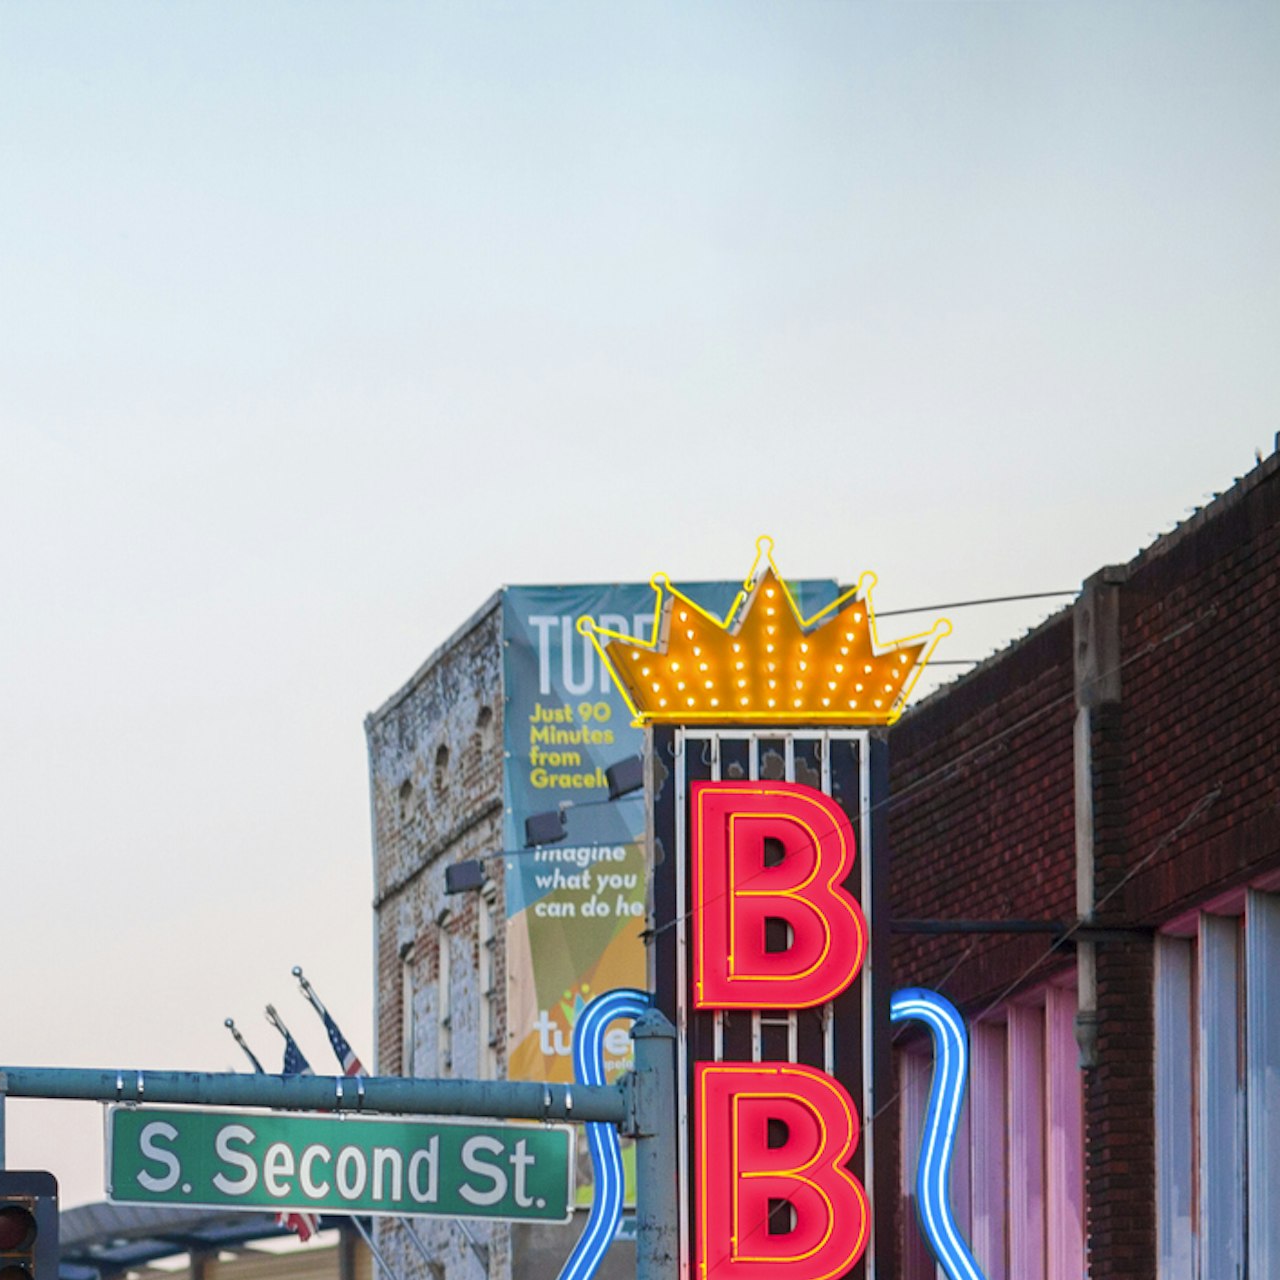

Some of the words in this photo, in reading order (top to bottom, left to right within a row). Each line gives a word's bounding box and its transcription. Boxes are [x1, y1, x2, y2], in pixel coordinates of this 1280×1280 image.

[529, 703, 575, 724] Just
[579, 702, 612, 723] 90
[529, 725, 615, 746] Minutes
[529, 748, 581, 768] from
[533, 844, 627, 864] imagine
[534, 870, 592, 891] what
[597, 875, 638, 897] you
[691, 780, 868, 1010] B
[534, 903, 577, 919] can
[581, 897, 609, 918] do
[136, 1120, 193, 1194] S.
[211, 1123, 439, 1203] Second
[457, 1135, 546, 1209] St.
